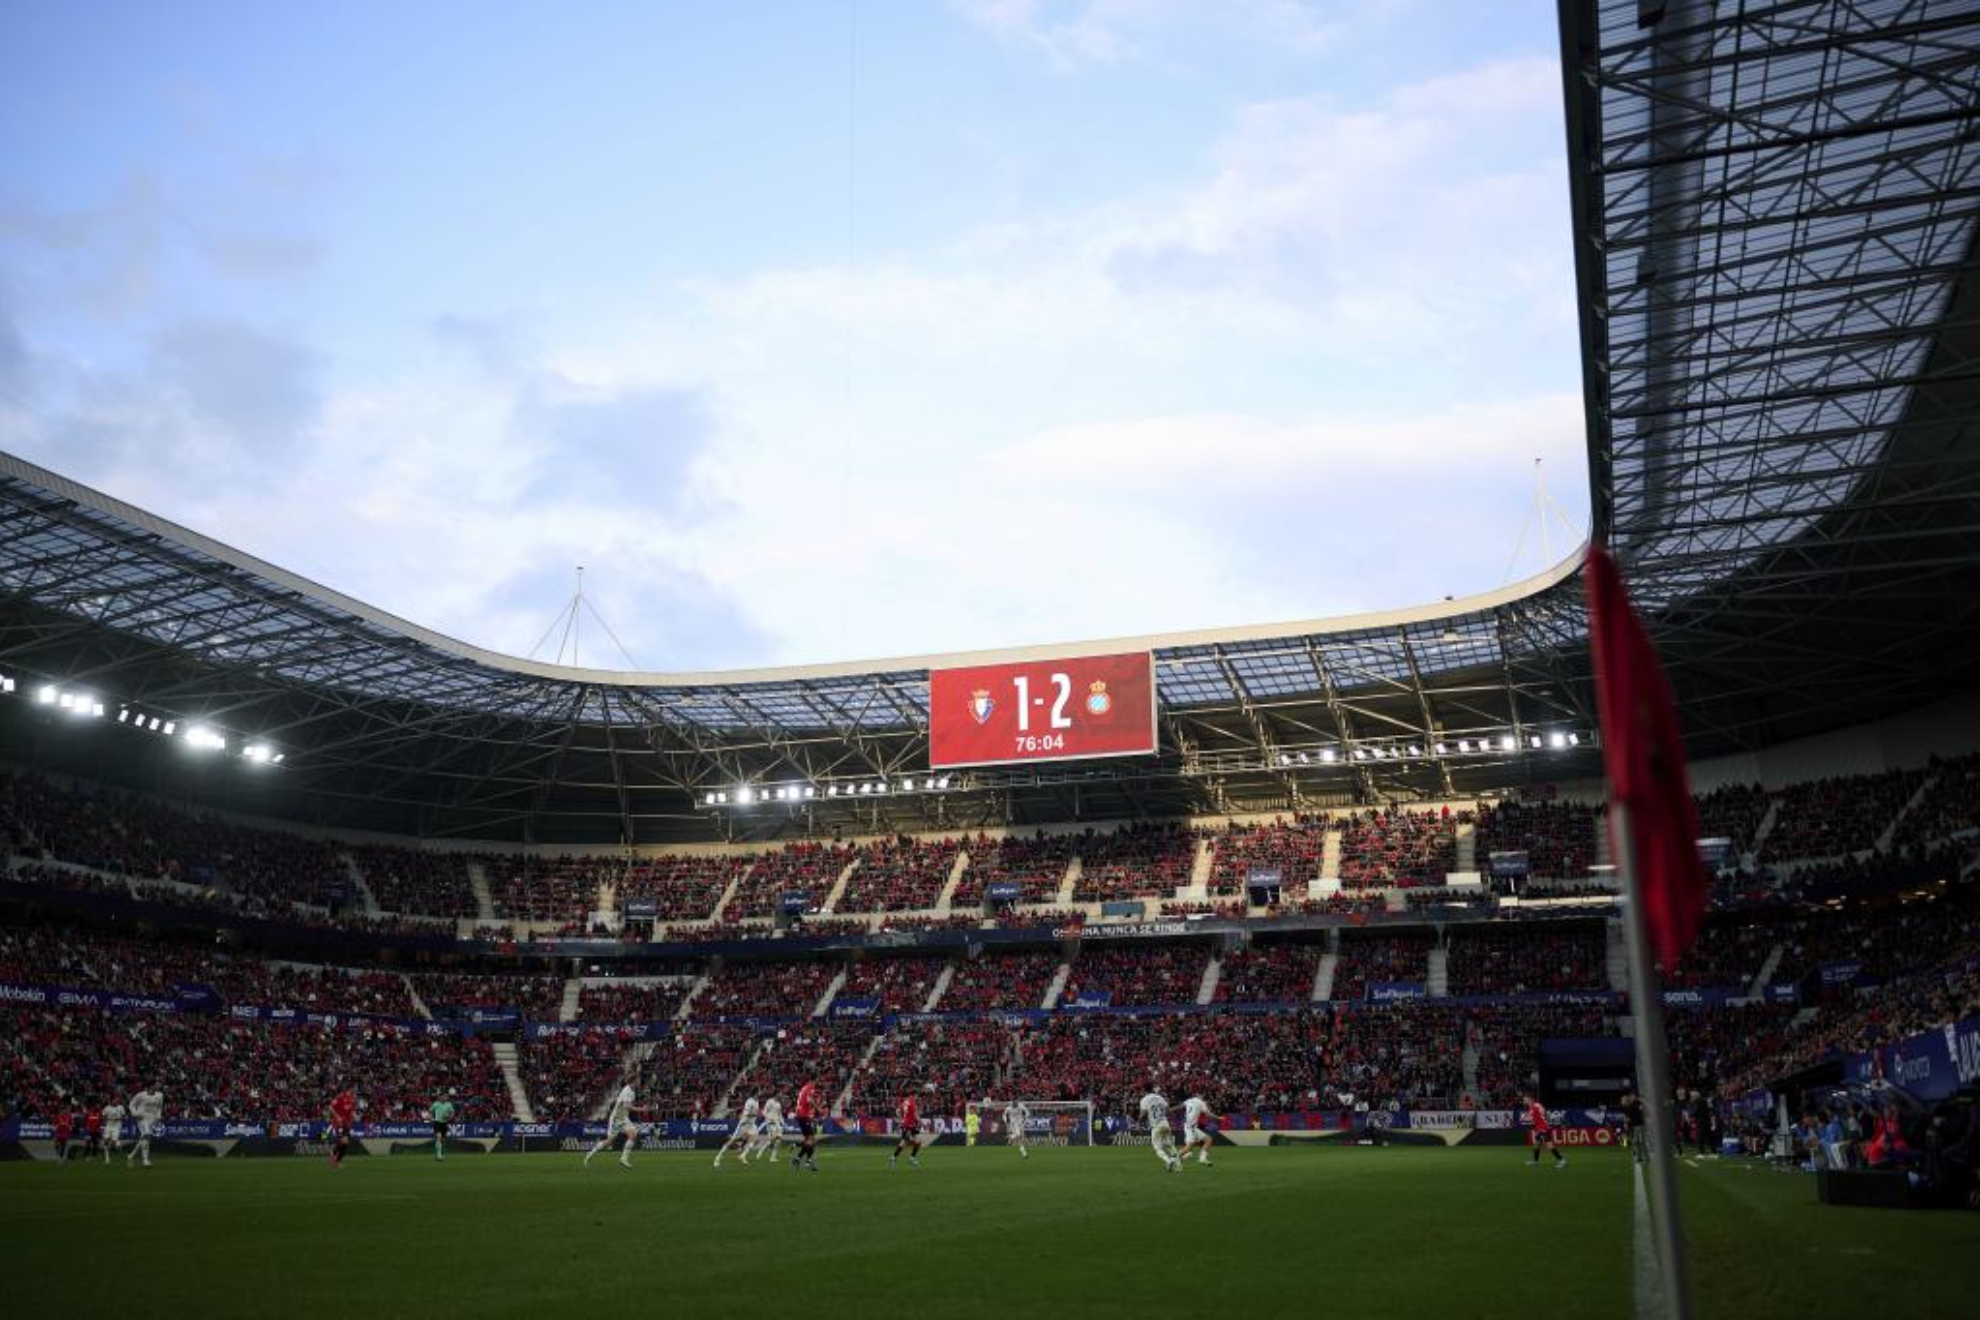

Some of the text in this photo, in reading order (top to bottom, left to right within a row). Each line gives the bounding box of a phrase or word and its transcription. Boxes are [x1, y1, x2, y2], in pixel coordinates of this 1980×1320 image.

[1014, 673, 1072, 731] 1-2
[1016, 735, 1064, 752] 76:04
[1101, 925, 1137, 936] NUNCA
[1139, 924, 1152, 934] SE
[1154, 922, 1186, 933] RINDE
